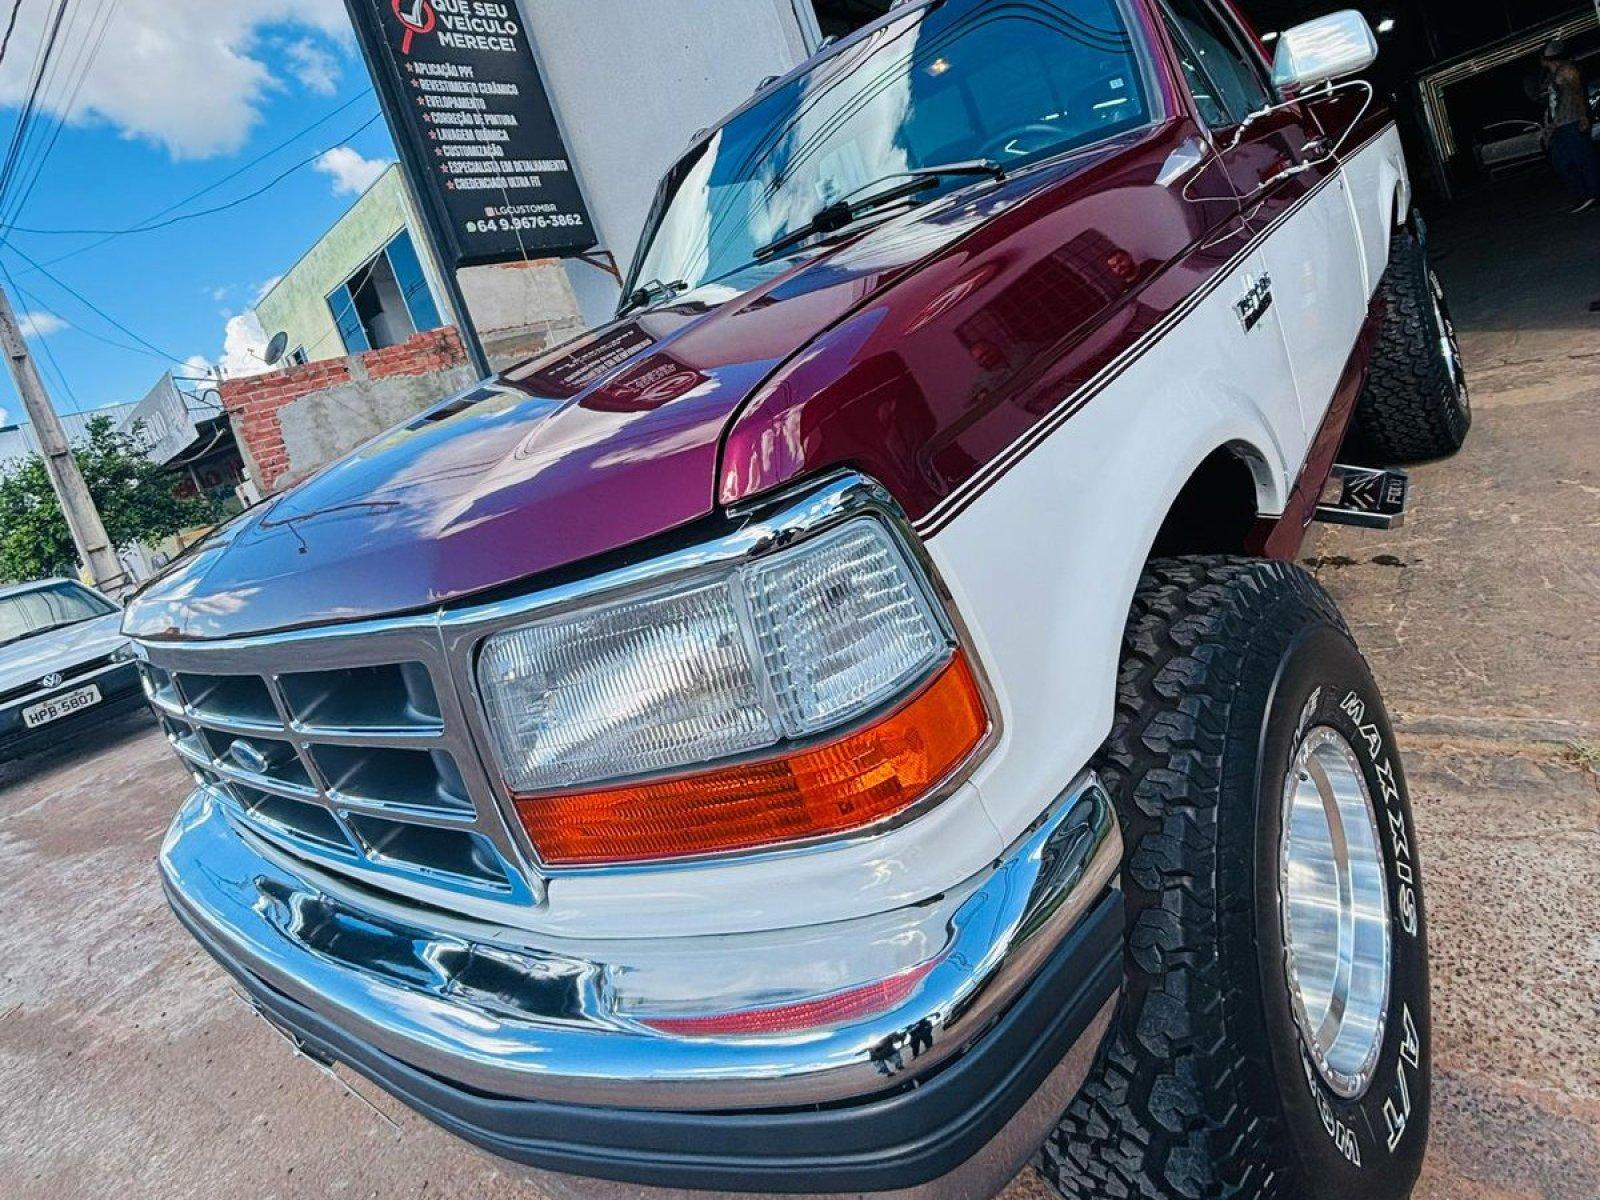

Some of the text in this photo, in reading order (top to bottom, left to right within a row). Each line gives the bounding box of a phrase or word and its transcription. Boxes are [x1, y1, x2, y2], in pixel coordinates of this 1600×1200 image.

[431, 0, 508, 18] QUE SEU
[440, 13, 518, 35] VEÍCULO
[437, 31, 517, 52] MERECE!
[419, 79, 478, 93] REVESTIMENTO
[430, 111, 519, 127] CORREÇÃO DE PINTURA
[436, 127, 476, 141] LAVAGEM
[442, 143, 505, 157] CUSTOMIZAÇÃO
[447, 160, 501, 173] ESPECIALISTA
[499, 160, 514, 172] EM
[495, 203, 558, 215] LGCUSTOMBR
[476, 213, 584, 233] 64 9.9676-3862
[1339, 690, 1417, 938] MAXXIS
